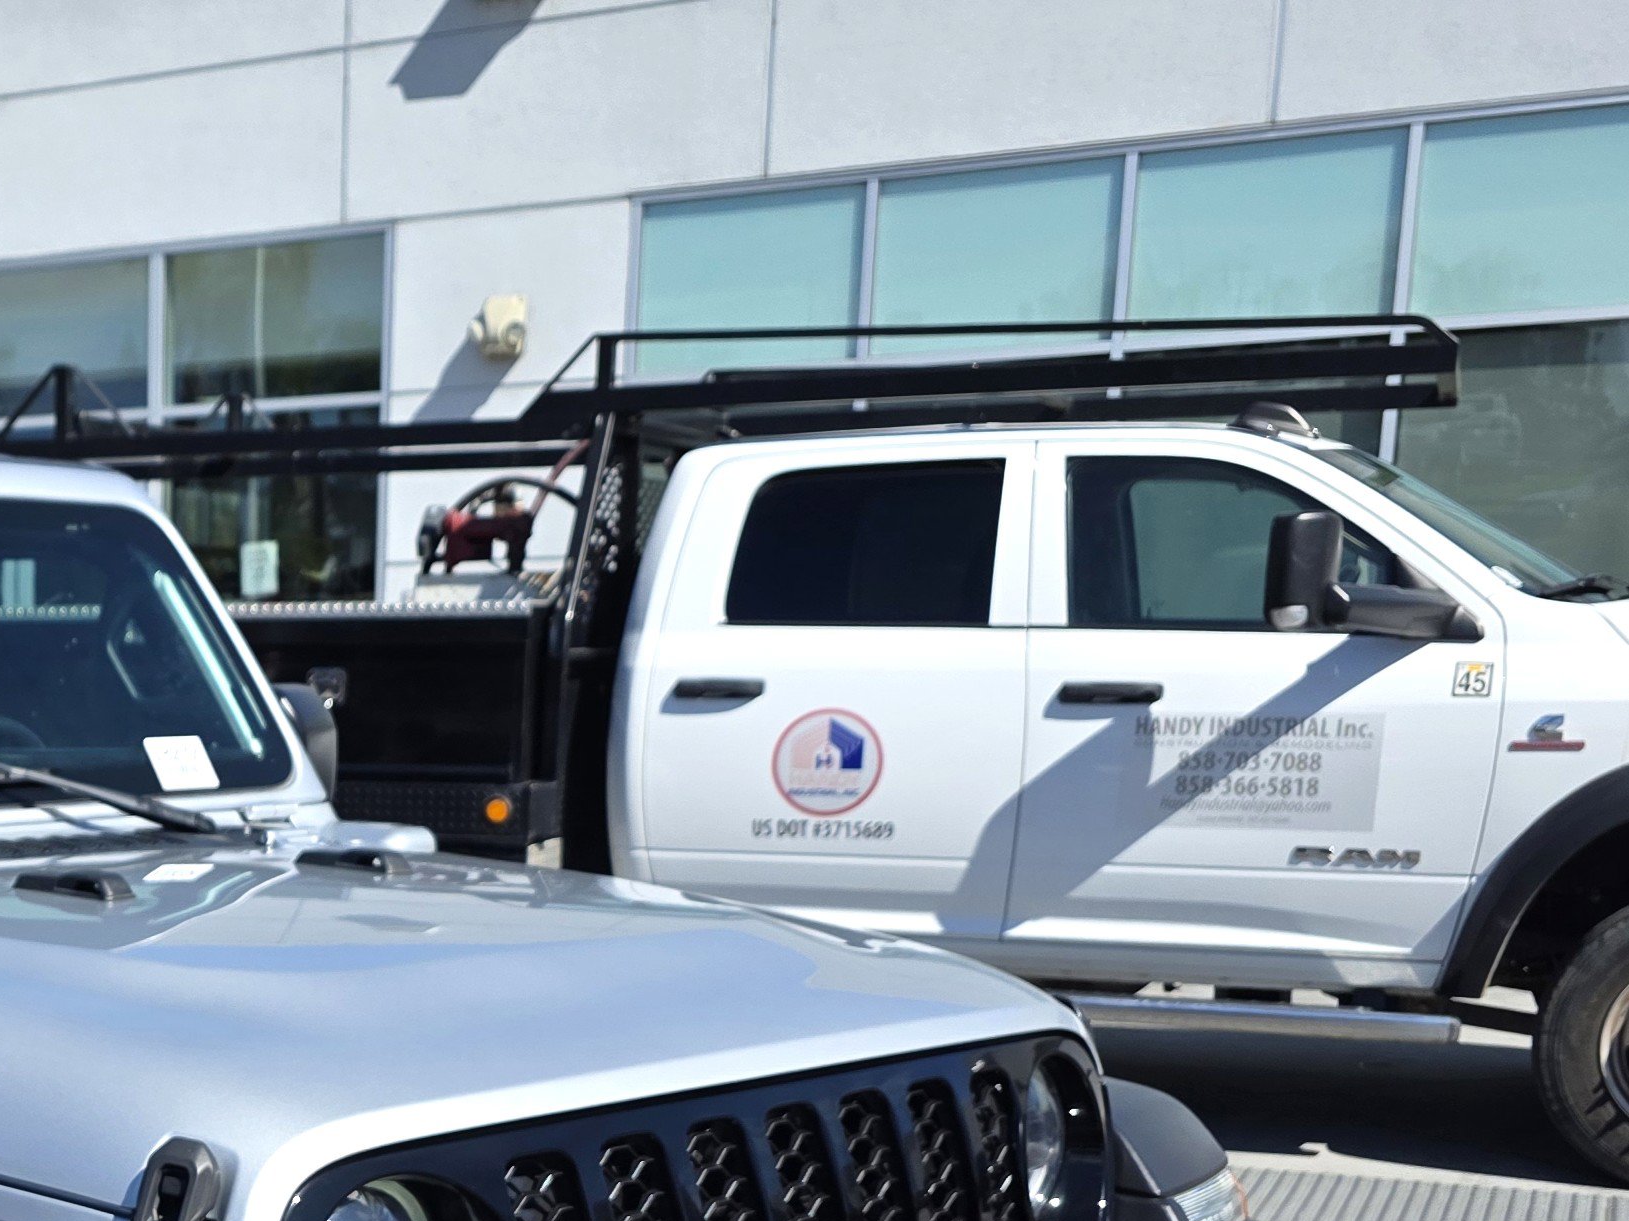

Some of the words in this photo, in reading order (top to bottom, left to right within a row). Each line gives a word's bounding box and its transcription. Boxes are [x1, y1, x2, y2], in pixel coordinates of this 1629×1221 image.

[1458, 671, 1487, 693] 45
[1134, 716, 1203, 736] HANDY
[1209, 716, 1330, 737] INDUSTRIAL
[1336, 717, 1373, 738] Inc.
[752, 818, 772, 838] US
[776, 818, 809, 838] DOT
[812, 820, 895, 839] #3715689
[1286, 846, 1421, 869] RAM
